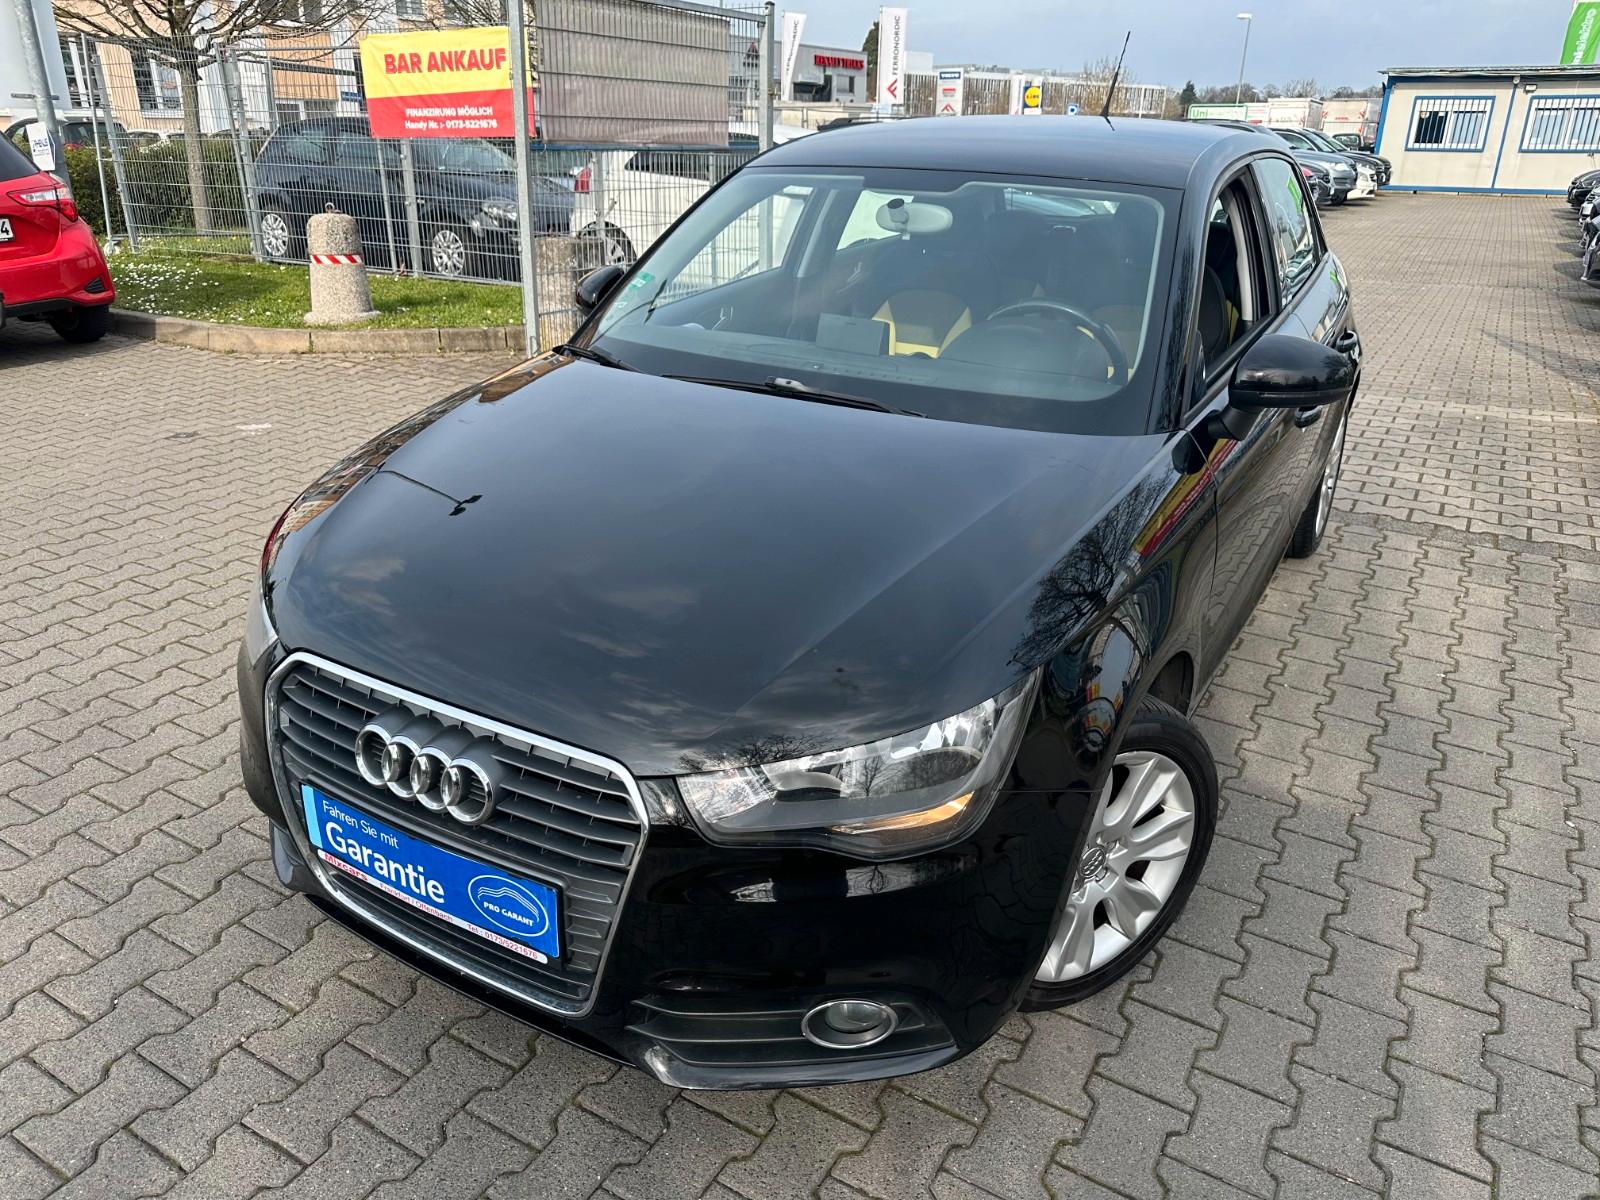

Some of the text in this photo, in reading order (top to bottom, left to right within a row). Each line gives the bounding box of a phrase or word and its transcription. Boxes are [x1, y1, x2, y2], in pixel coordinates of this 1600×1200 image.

[383, 48, 507, 74] BAR ANKAUF
[457, 105, 493, 116] MÖGLICH
[405, 120, 427, 131] Handy
[322, 800, 399, 849] Fahren Sie mit
[324, 853, 368, 880] Mixcars
[325, 821, 445, 904] Garantie
[379, 883, 410, 904] Frankfurt
[415, 901, 454, 923] Offenbach
[483, 901, 535, 927] PRO GARANT
